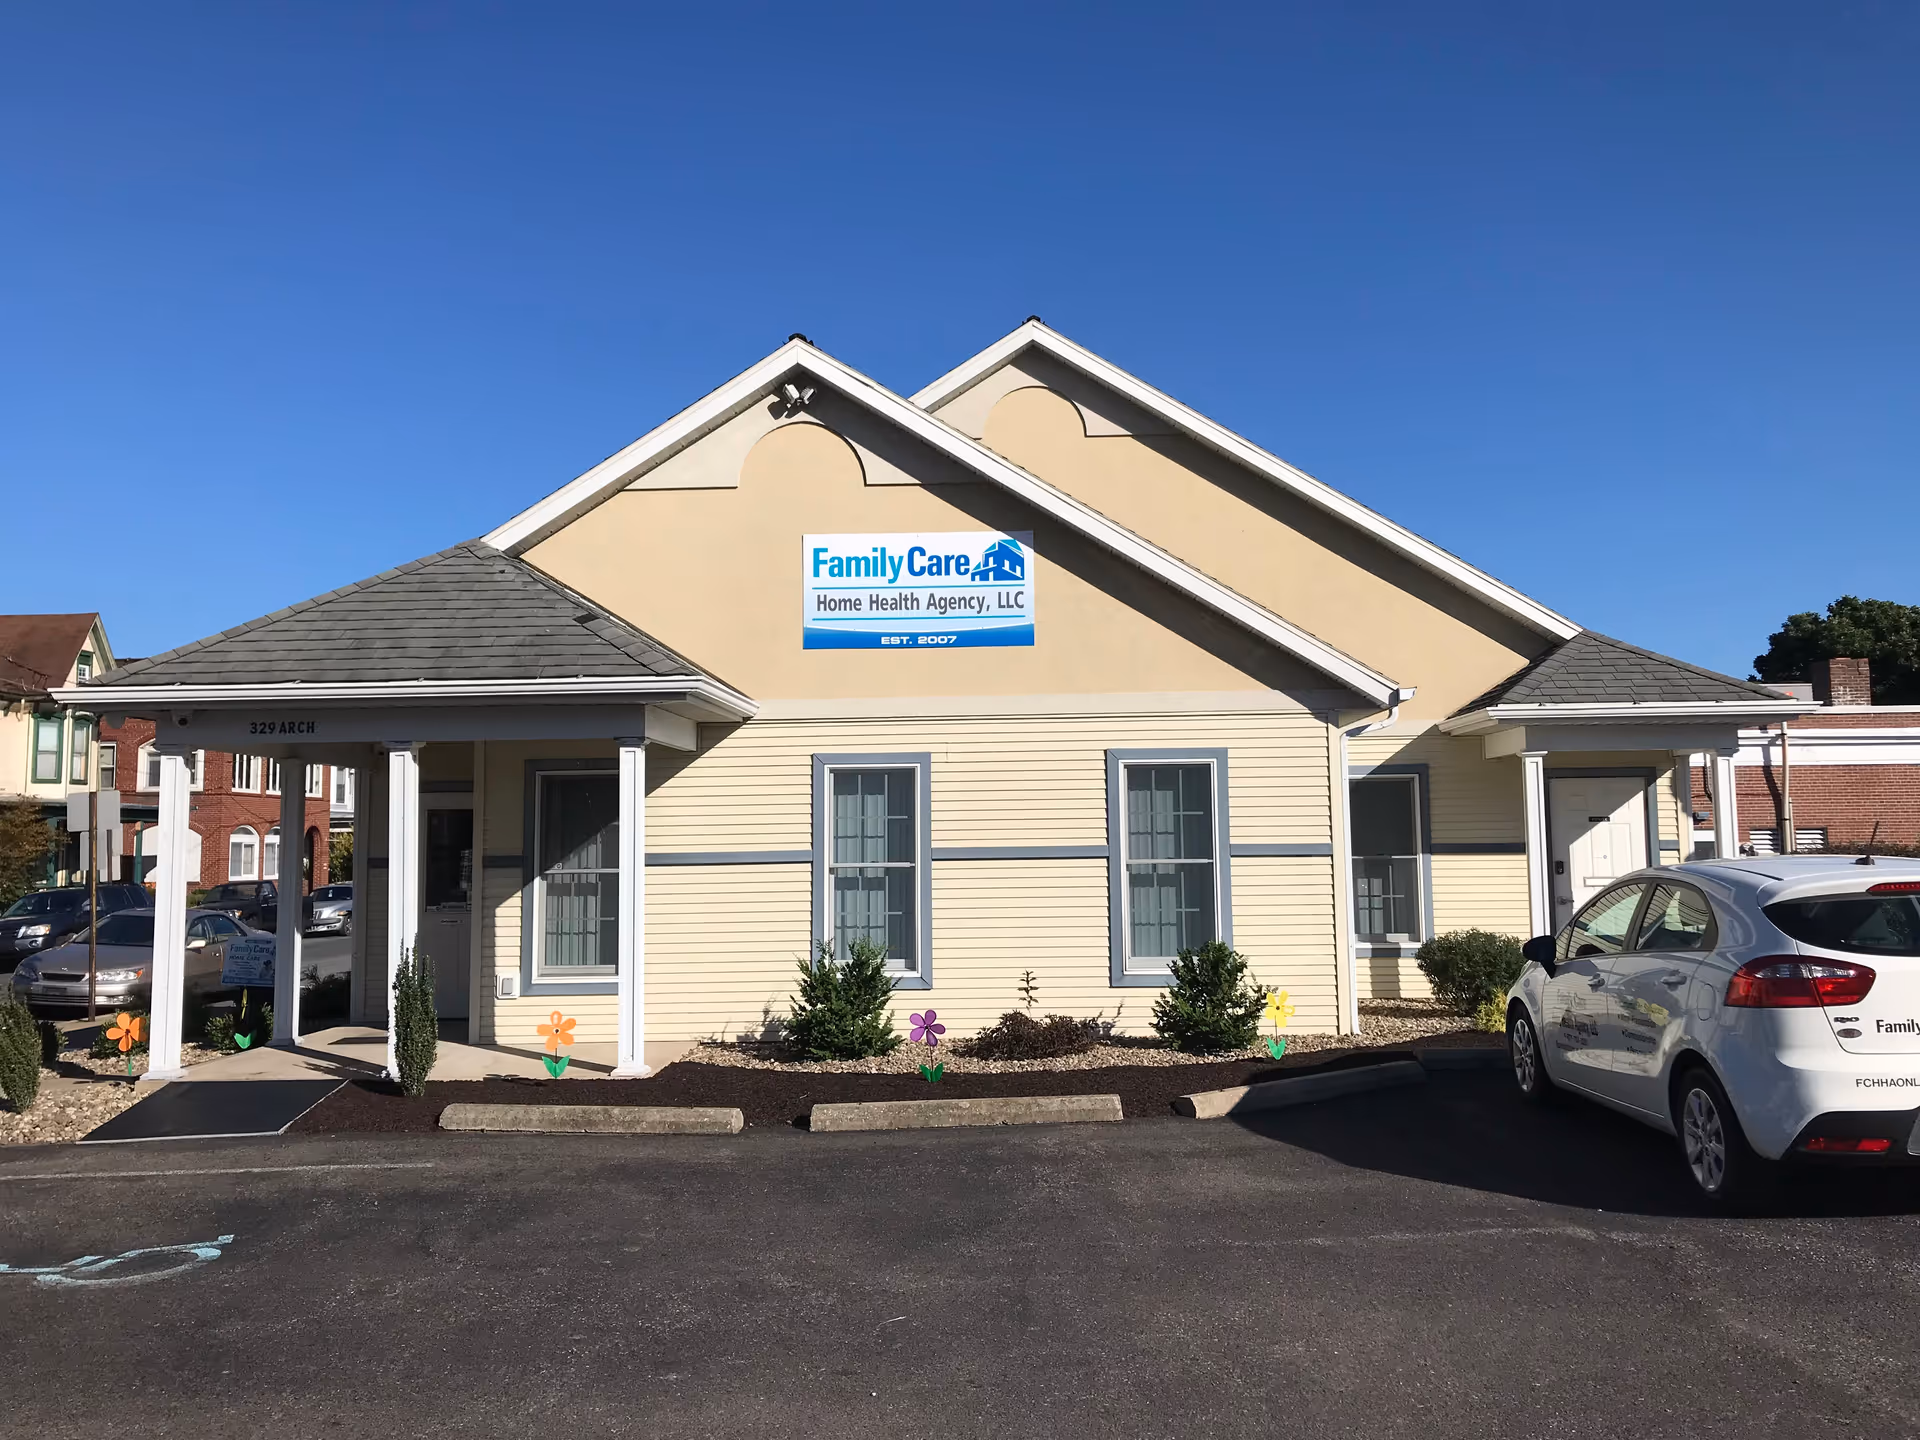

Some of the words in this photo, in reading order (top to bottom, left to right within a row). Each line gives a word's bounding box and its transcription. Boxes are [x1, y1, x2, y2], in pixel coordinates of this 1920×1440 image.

[816, 594, 862, 612] Home
[869, 592, 920, 611] Health
[926, 593, 991, 615] Agency,
[997, 591, 1025, 609] LLC
[880, 636, 912, 645] EST.
[917, 635, 958, 645] 2007
[249, 721, 276, 734] 329
[278, 721, 315, 734] ARCH
